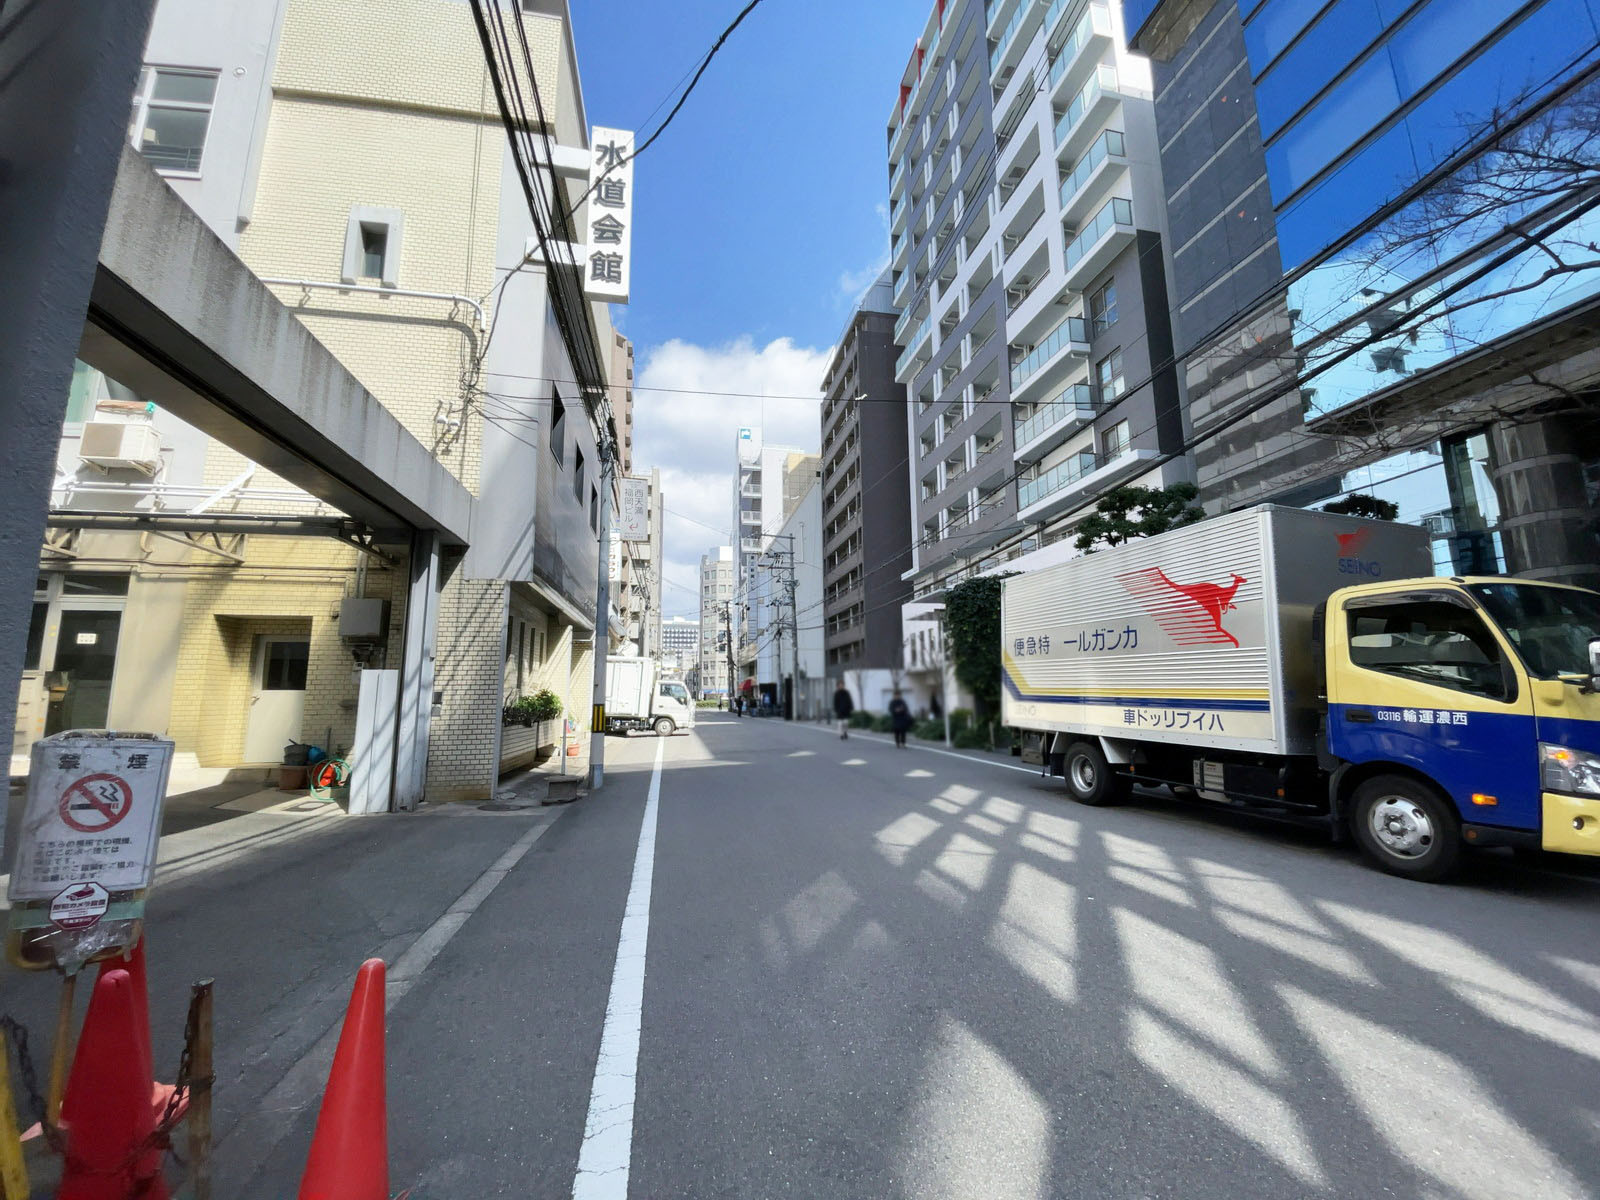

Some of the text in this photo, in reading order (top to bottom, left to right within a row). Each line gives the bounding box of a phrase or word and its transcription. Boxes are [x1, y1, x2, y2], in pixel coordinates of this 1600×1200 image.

[590, 140, 626, 284] 水道会館
[1377, 710, 1401, 722] 03116
